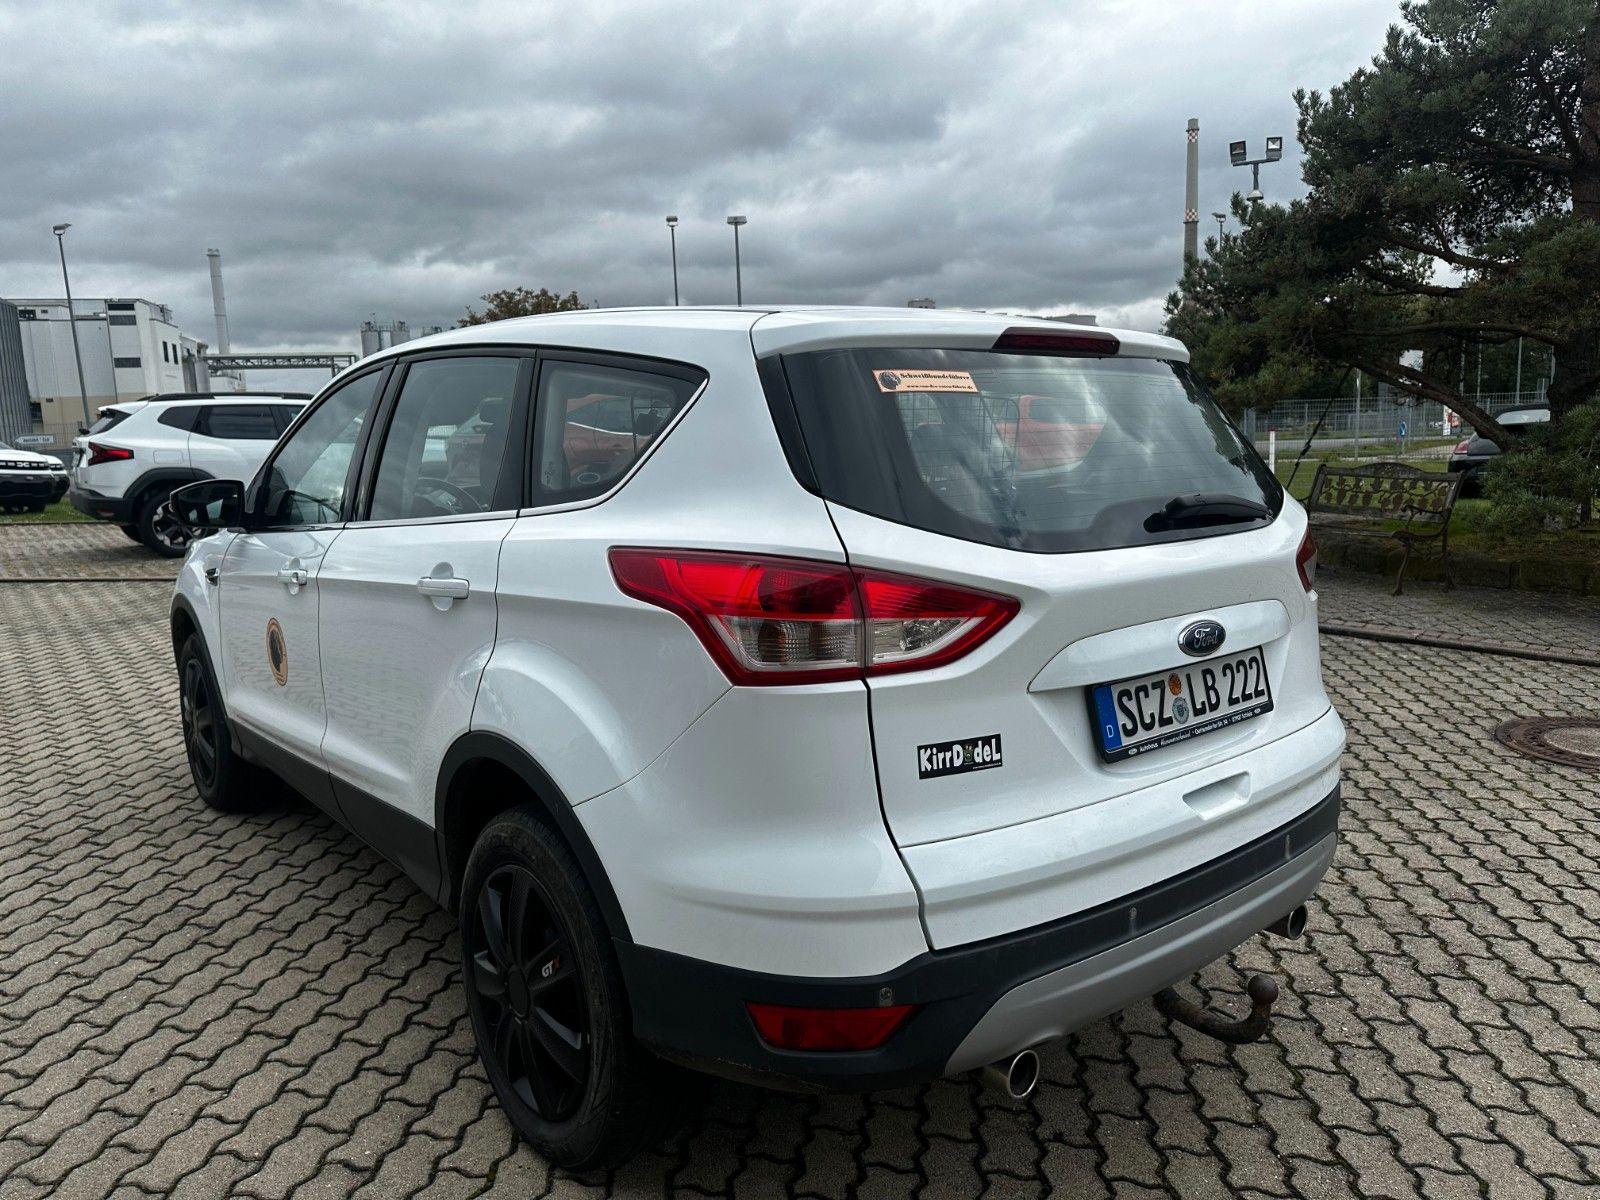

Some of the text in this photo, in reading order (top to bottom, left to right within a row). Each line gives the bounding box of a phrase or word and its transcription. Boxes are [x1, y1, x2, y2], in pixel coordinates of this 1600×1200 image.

[1193, 627, 1219, 648] Ford
[1116, 655, 1266, 738] SCZ LB 222
[1106, 724, 1114, 738] D
